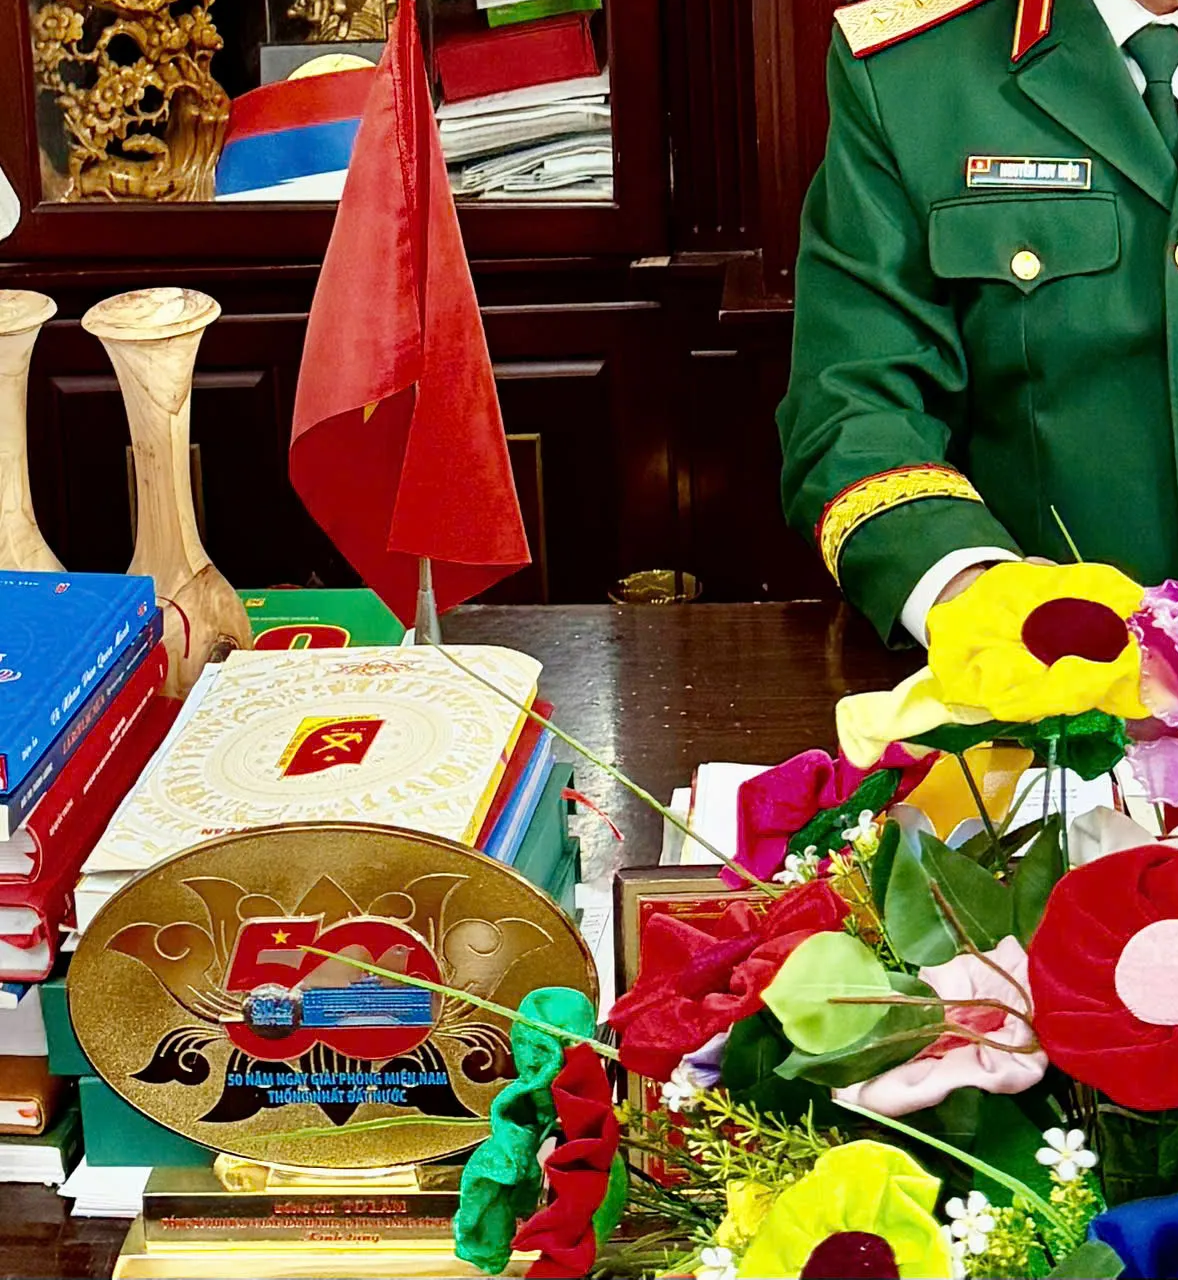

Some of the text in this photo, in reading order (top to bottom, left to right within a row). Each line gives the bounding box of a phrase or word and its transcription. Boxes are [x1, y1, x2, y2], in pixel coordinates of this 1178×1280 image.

[227, 1073, 243, 1087] 50
[245, 1070, 274, 1087] NĂM
[339, 1071, 382, 1086] PHÓNG
[419, 1071, 447, 1085] NAM
[267, 1087, 312, 1104] THỐNG
[312, 1087, 345, 1104] NHẤT
[372, 1087, 408, 1104] NƯỚC
